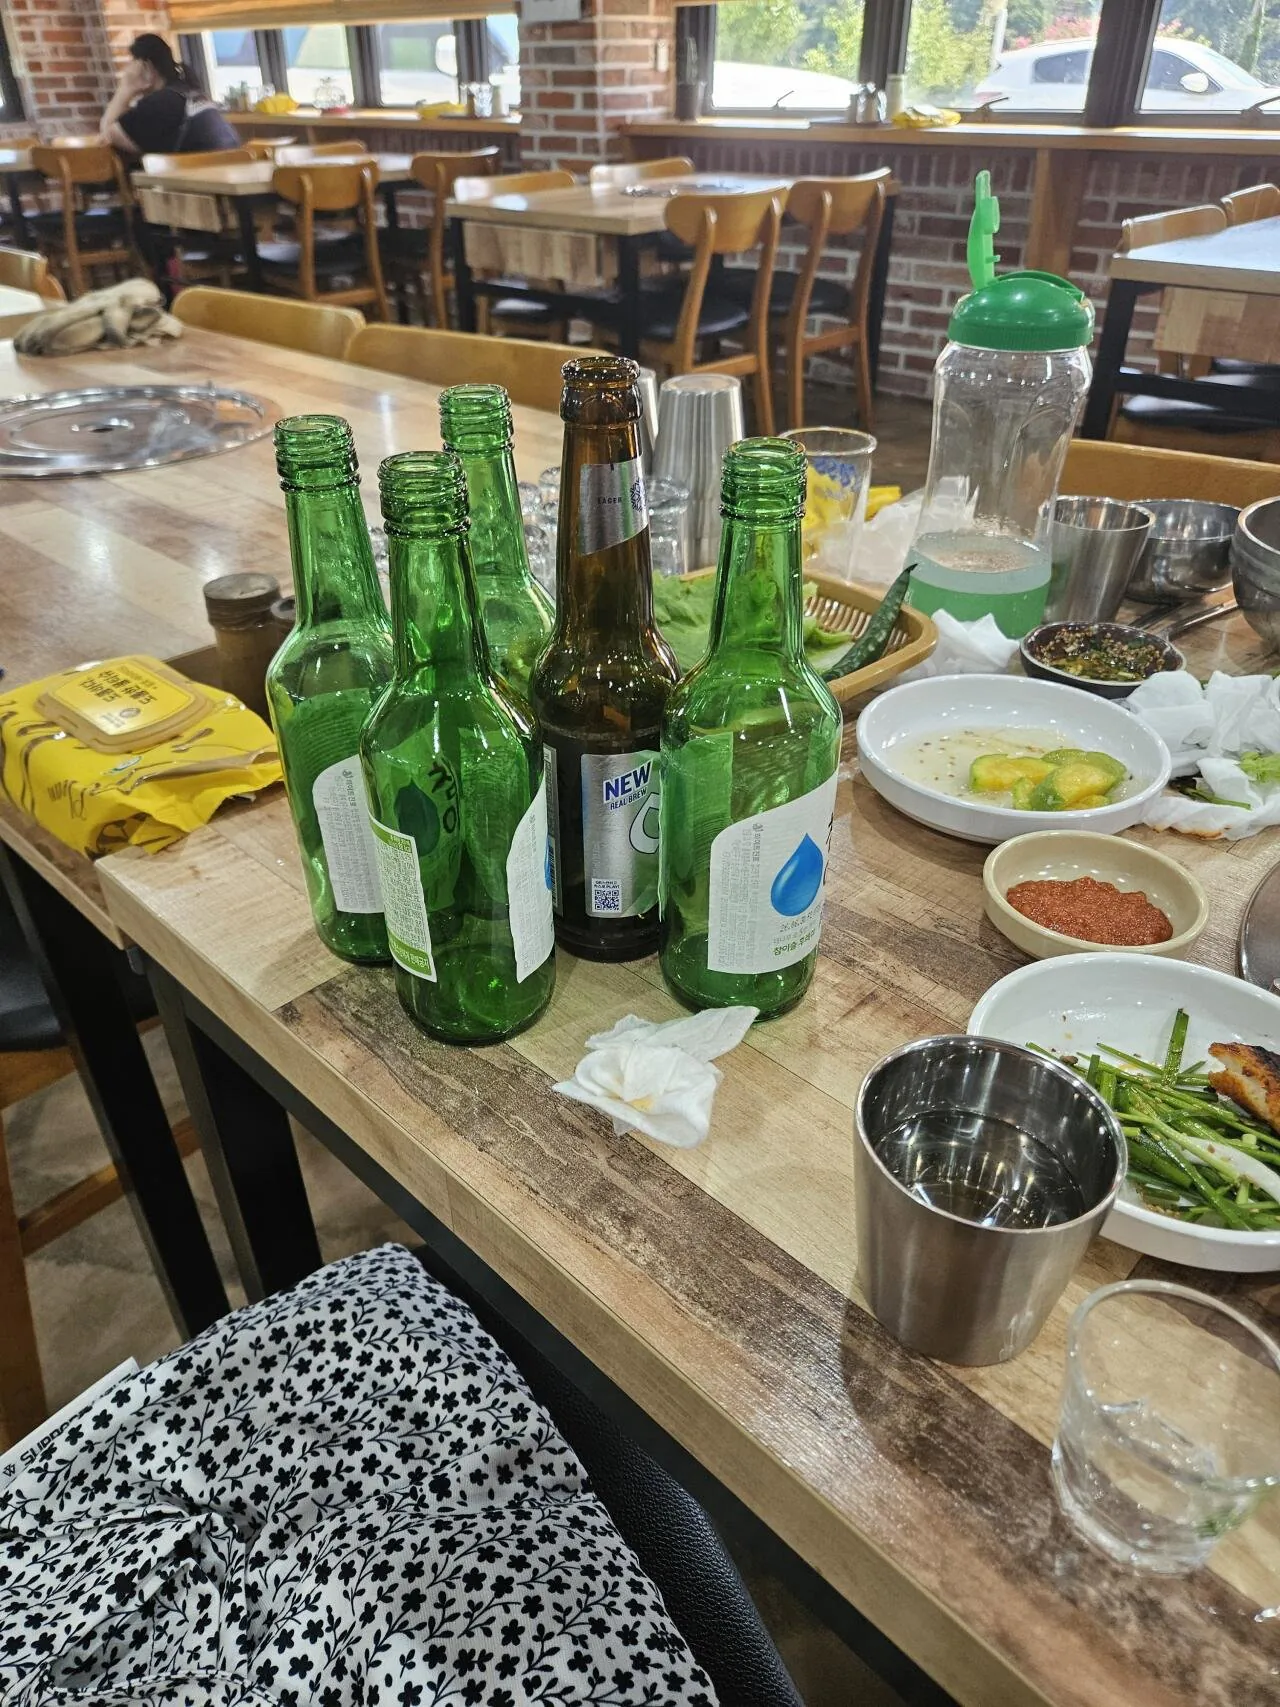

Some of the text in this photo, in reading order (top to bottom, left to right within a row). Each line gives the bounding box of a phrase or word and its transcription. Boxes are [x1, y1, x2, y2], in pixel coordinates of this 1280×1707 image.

[605, 761, 651, 801] NEW
[610, 787, 648, 811] REAL BREW
